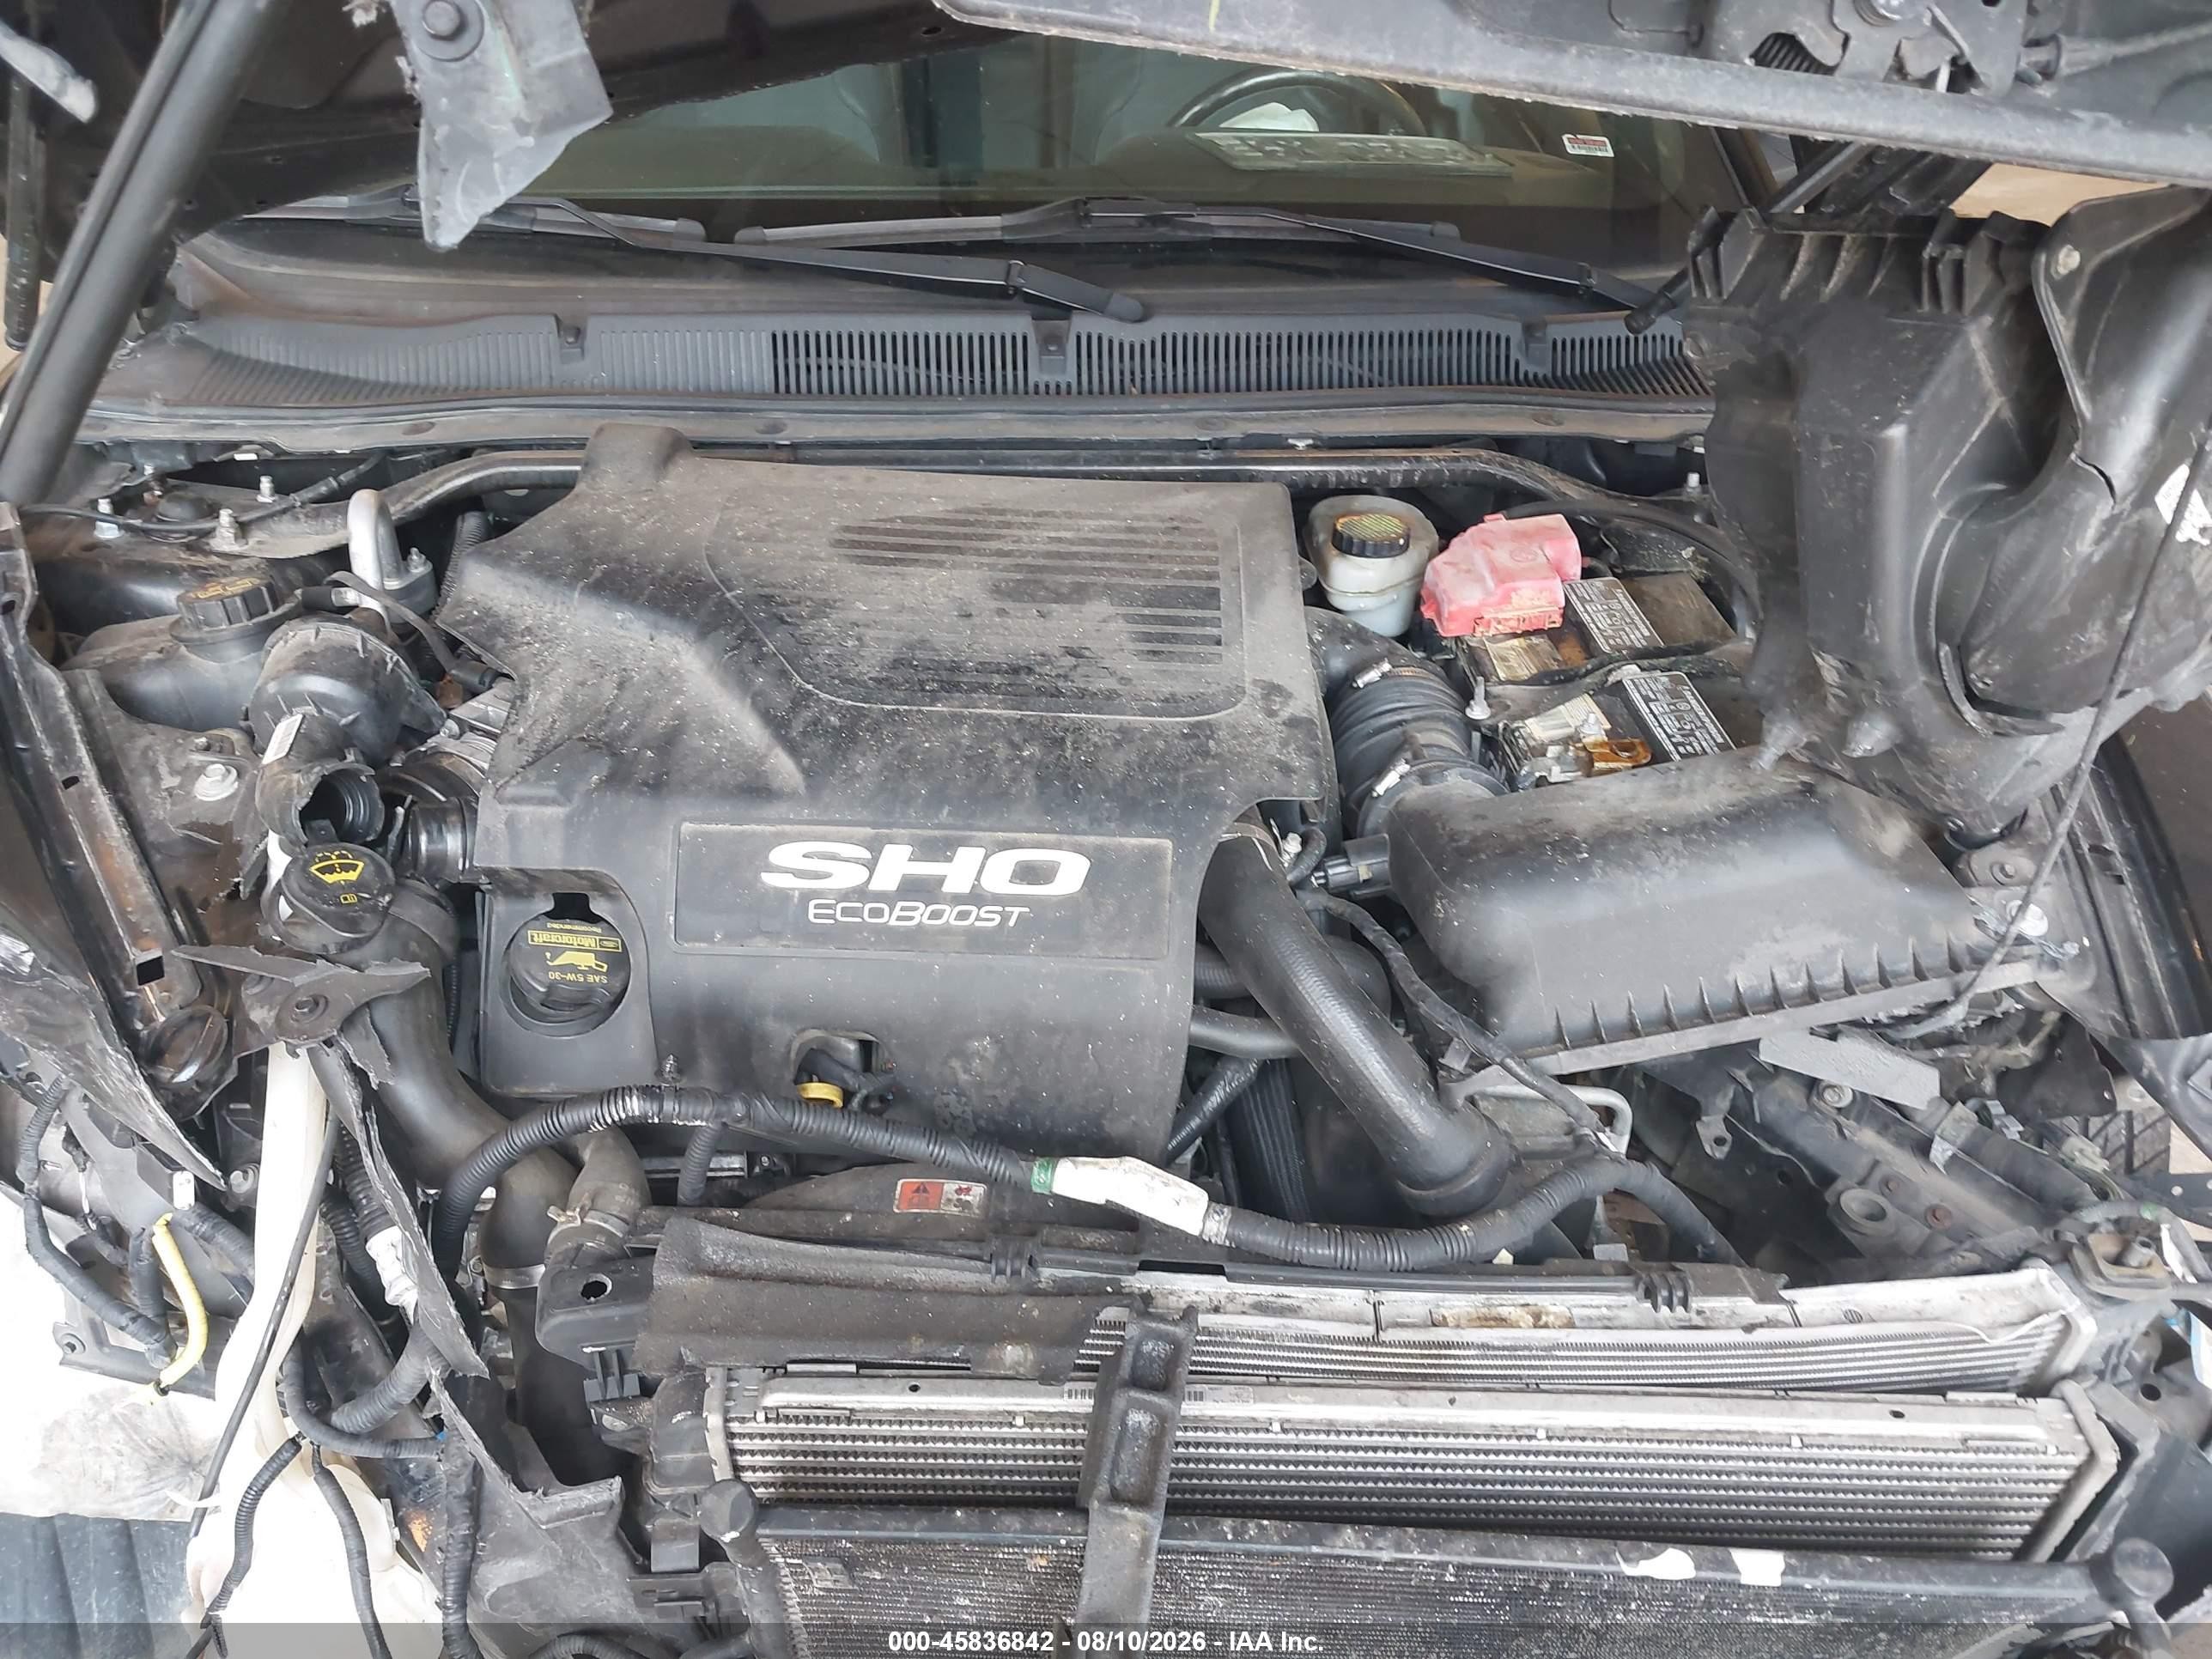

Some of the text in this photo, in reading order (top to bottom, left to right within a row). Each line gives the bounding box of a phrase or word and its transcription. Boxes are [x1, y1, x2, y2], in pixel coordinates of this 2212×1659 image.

[761, 841, 1091, 896] SHO
[533, 933, 597, 947] Motorcraft
[549, 972, 608, 983] SAE 5W-30
